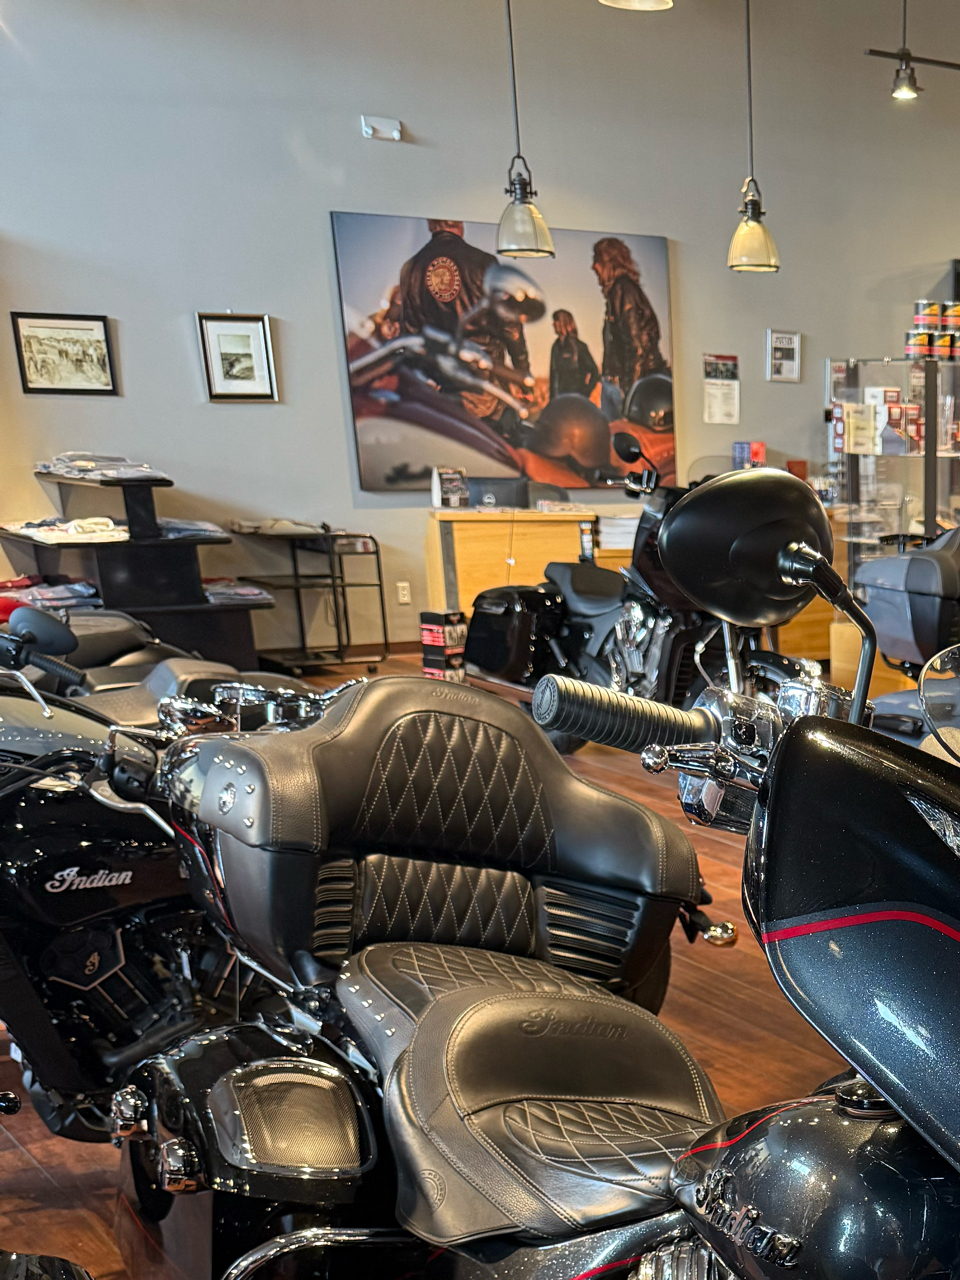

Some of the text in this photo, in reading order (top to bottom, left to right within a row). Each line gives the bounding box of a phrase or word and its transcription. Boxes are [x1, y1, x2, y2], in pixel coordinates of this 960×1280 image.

[432, 686, 480, 704] Indian
[44, 866, 134, 893] Indian
[518, 1006, 629, 1041] Indian
[693, 1166, 802, 1269] Indian
